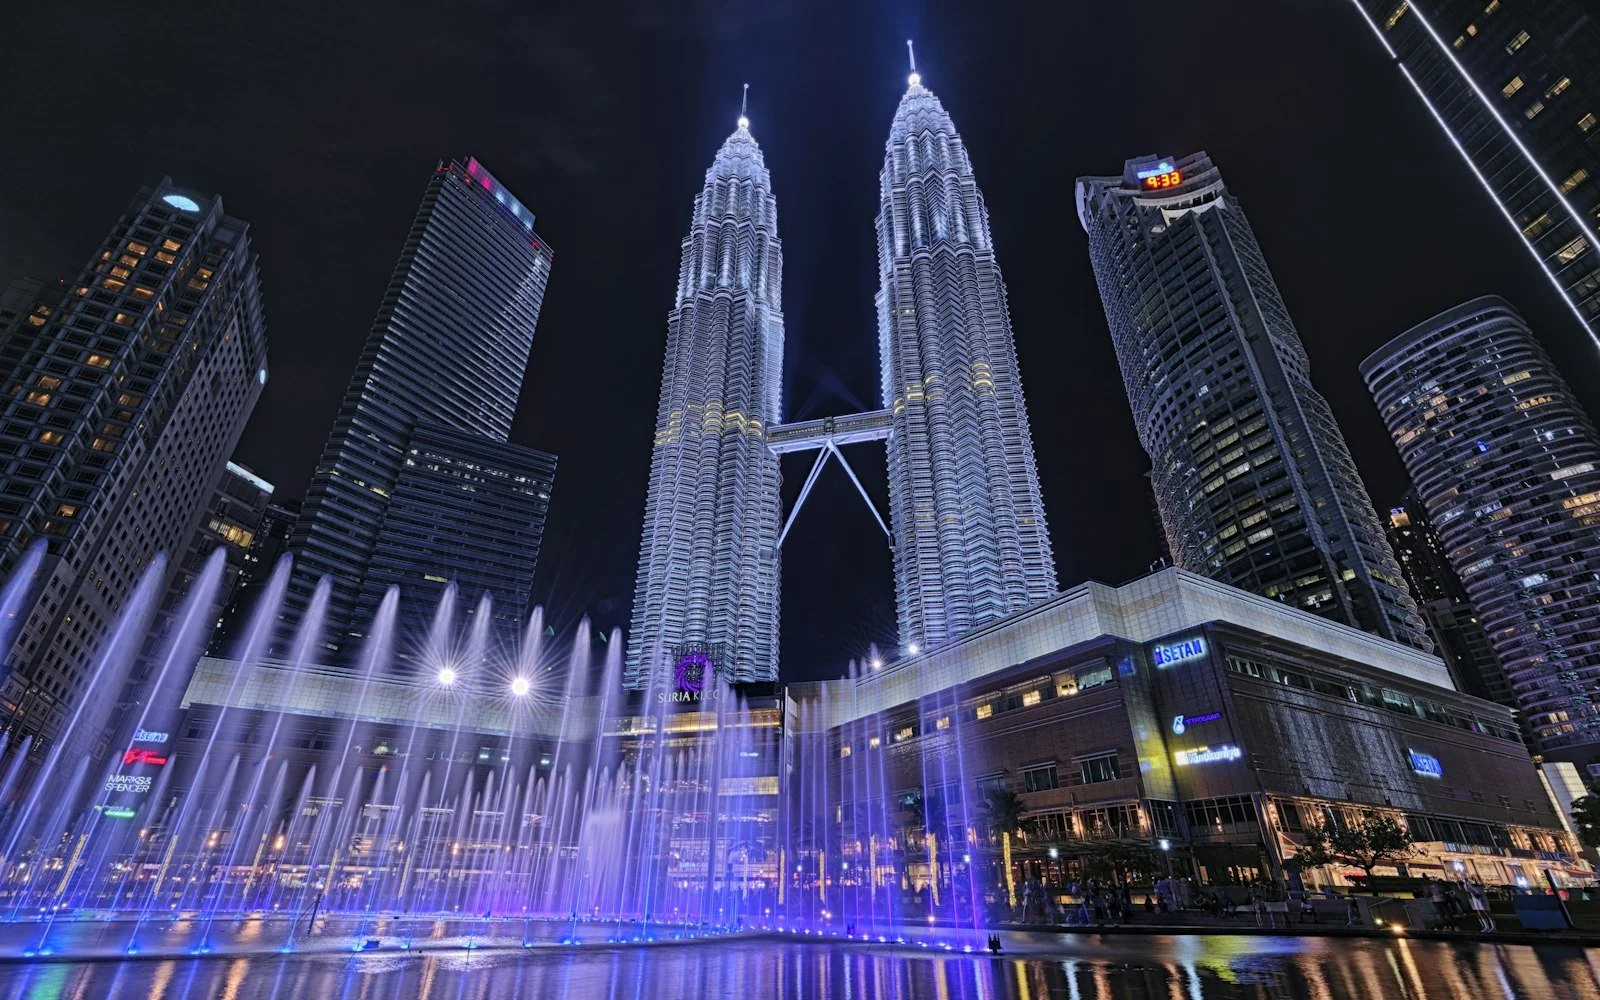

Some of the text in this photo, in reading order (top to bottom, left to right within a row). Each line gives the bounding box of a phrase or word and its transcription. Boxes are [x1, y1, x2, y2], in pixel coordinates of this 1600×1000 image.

[658, 689, 721, 704] SURIA KLCC
[1188, 745, 1241, 764] Kinokuniya
[104, 782, 150, 793] SPENCER
